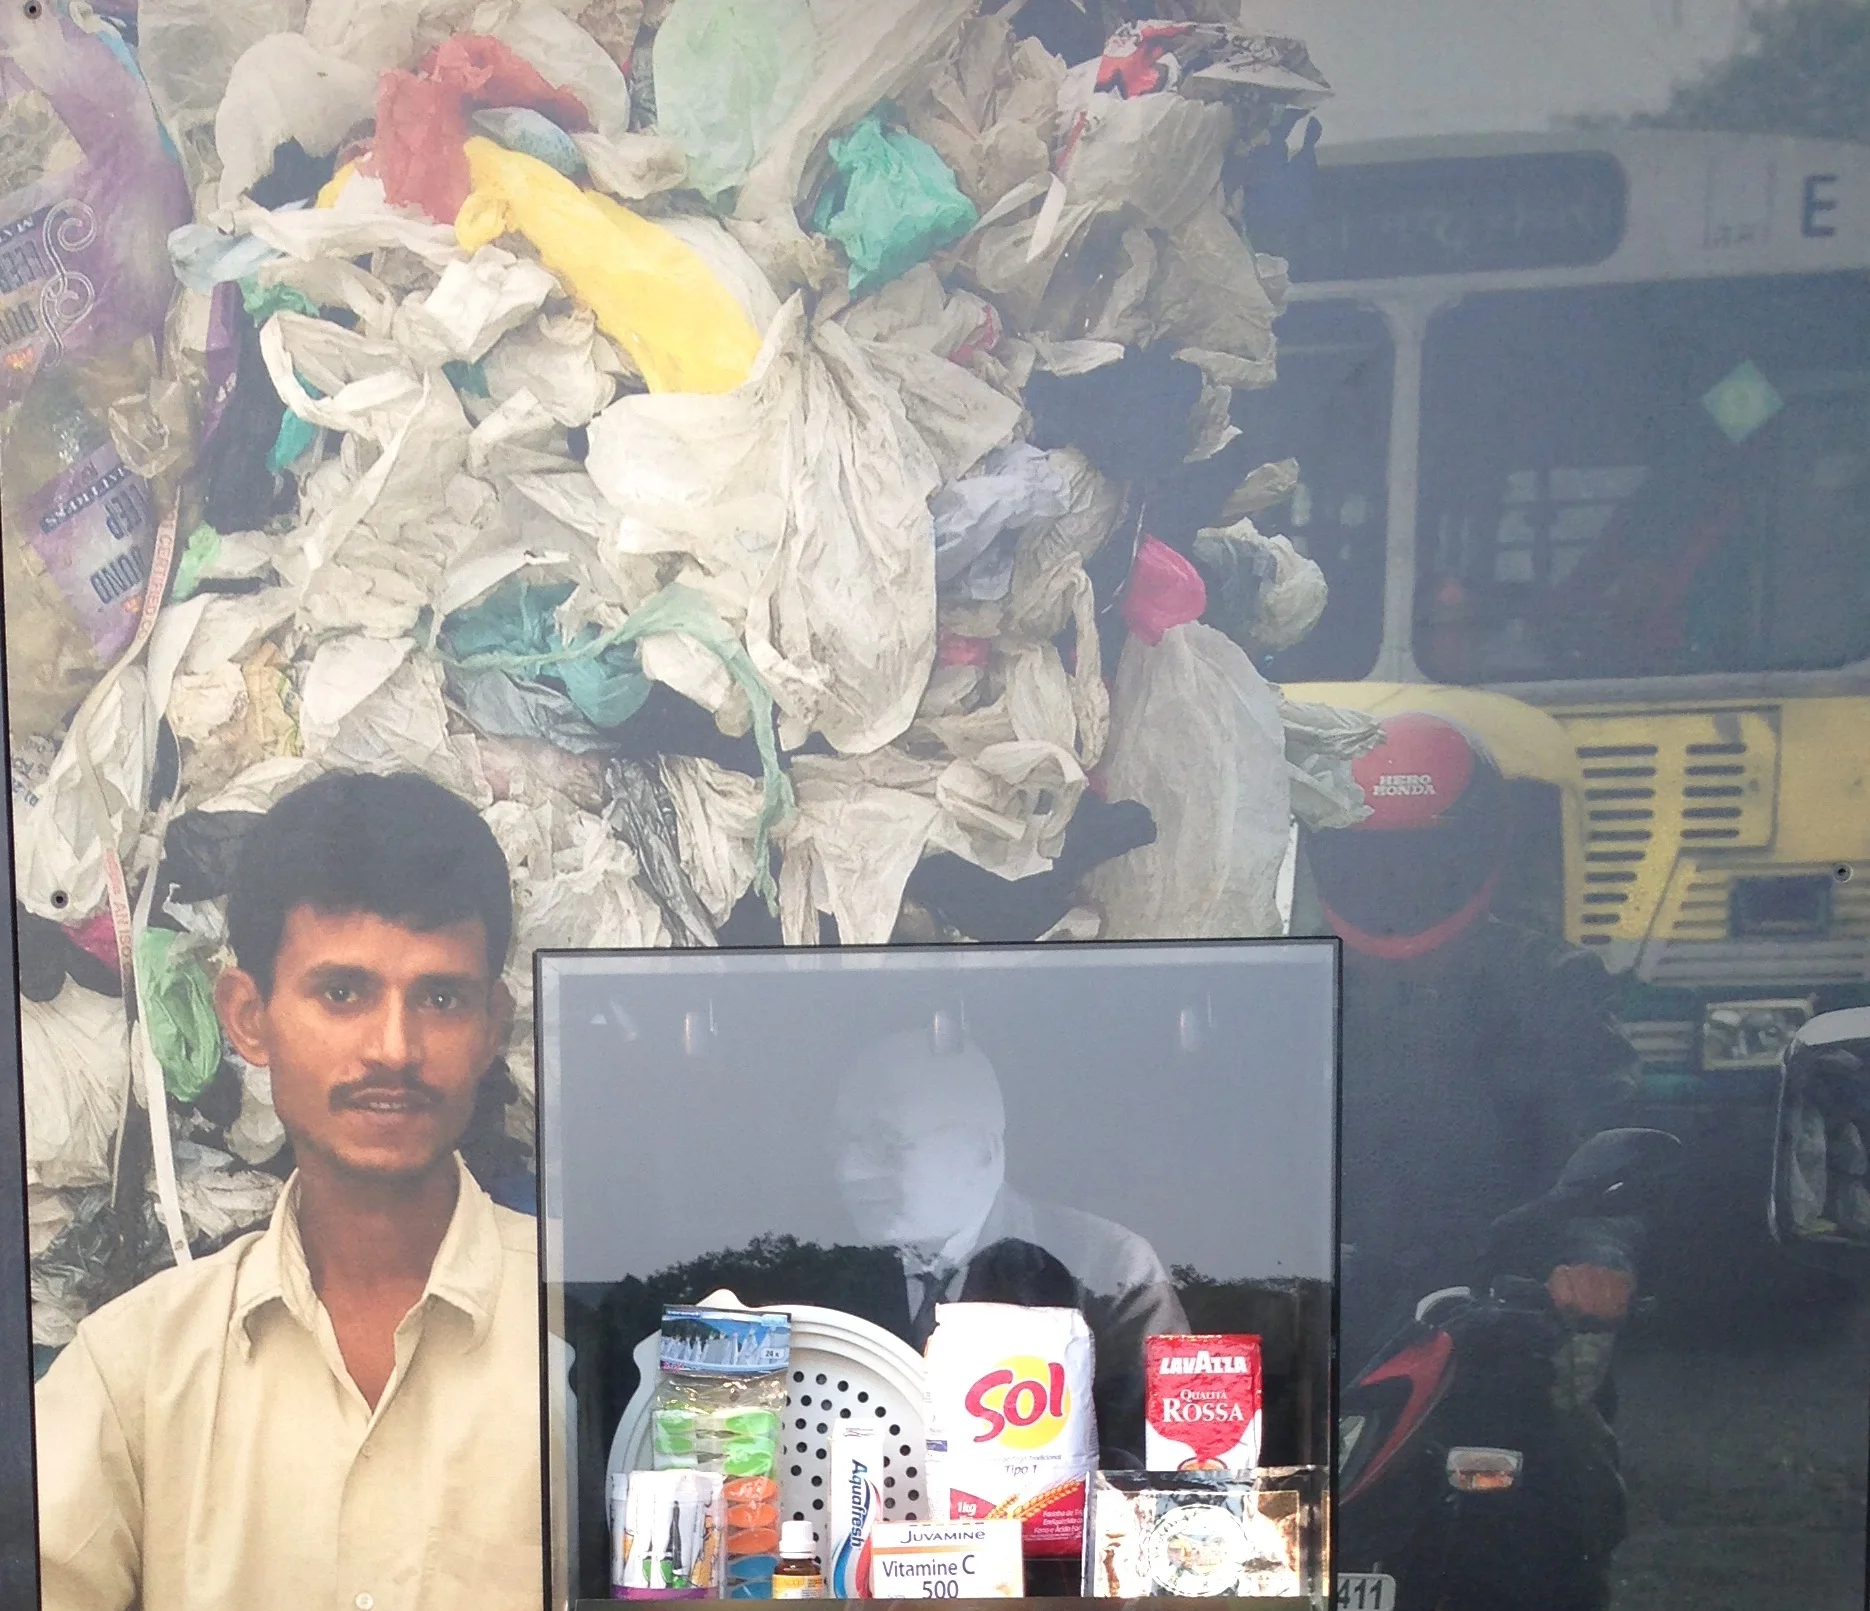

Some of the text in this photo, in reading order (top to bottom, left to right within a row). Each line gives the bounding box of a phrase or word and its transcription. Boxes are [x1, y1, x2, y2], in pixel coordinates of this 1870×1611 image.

[1803, 174, 1838, 238] E
[1373, 784, 1436, 796] HONDA
[1379, 775, 1432, 785] HERO
[1159, 1350, 1248, 1374] LAVAZZA
[965, 1362, 1065, 1443] Sol
[1162, 1397, 1245, 1423] ROSSA
[1004, 1464, 1029, 1478] Tipo
[848, 1459, 868, 1548] Aquafresh
[882, 1554, 976, 1577] Vitamine C
[922, 1580, 959, 1599] 500
